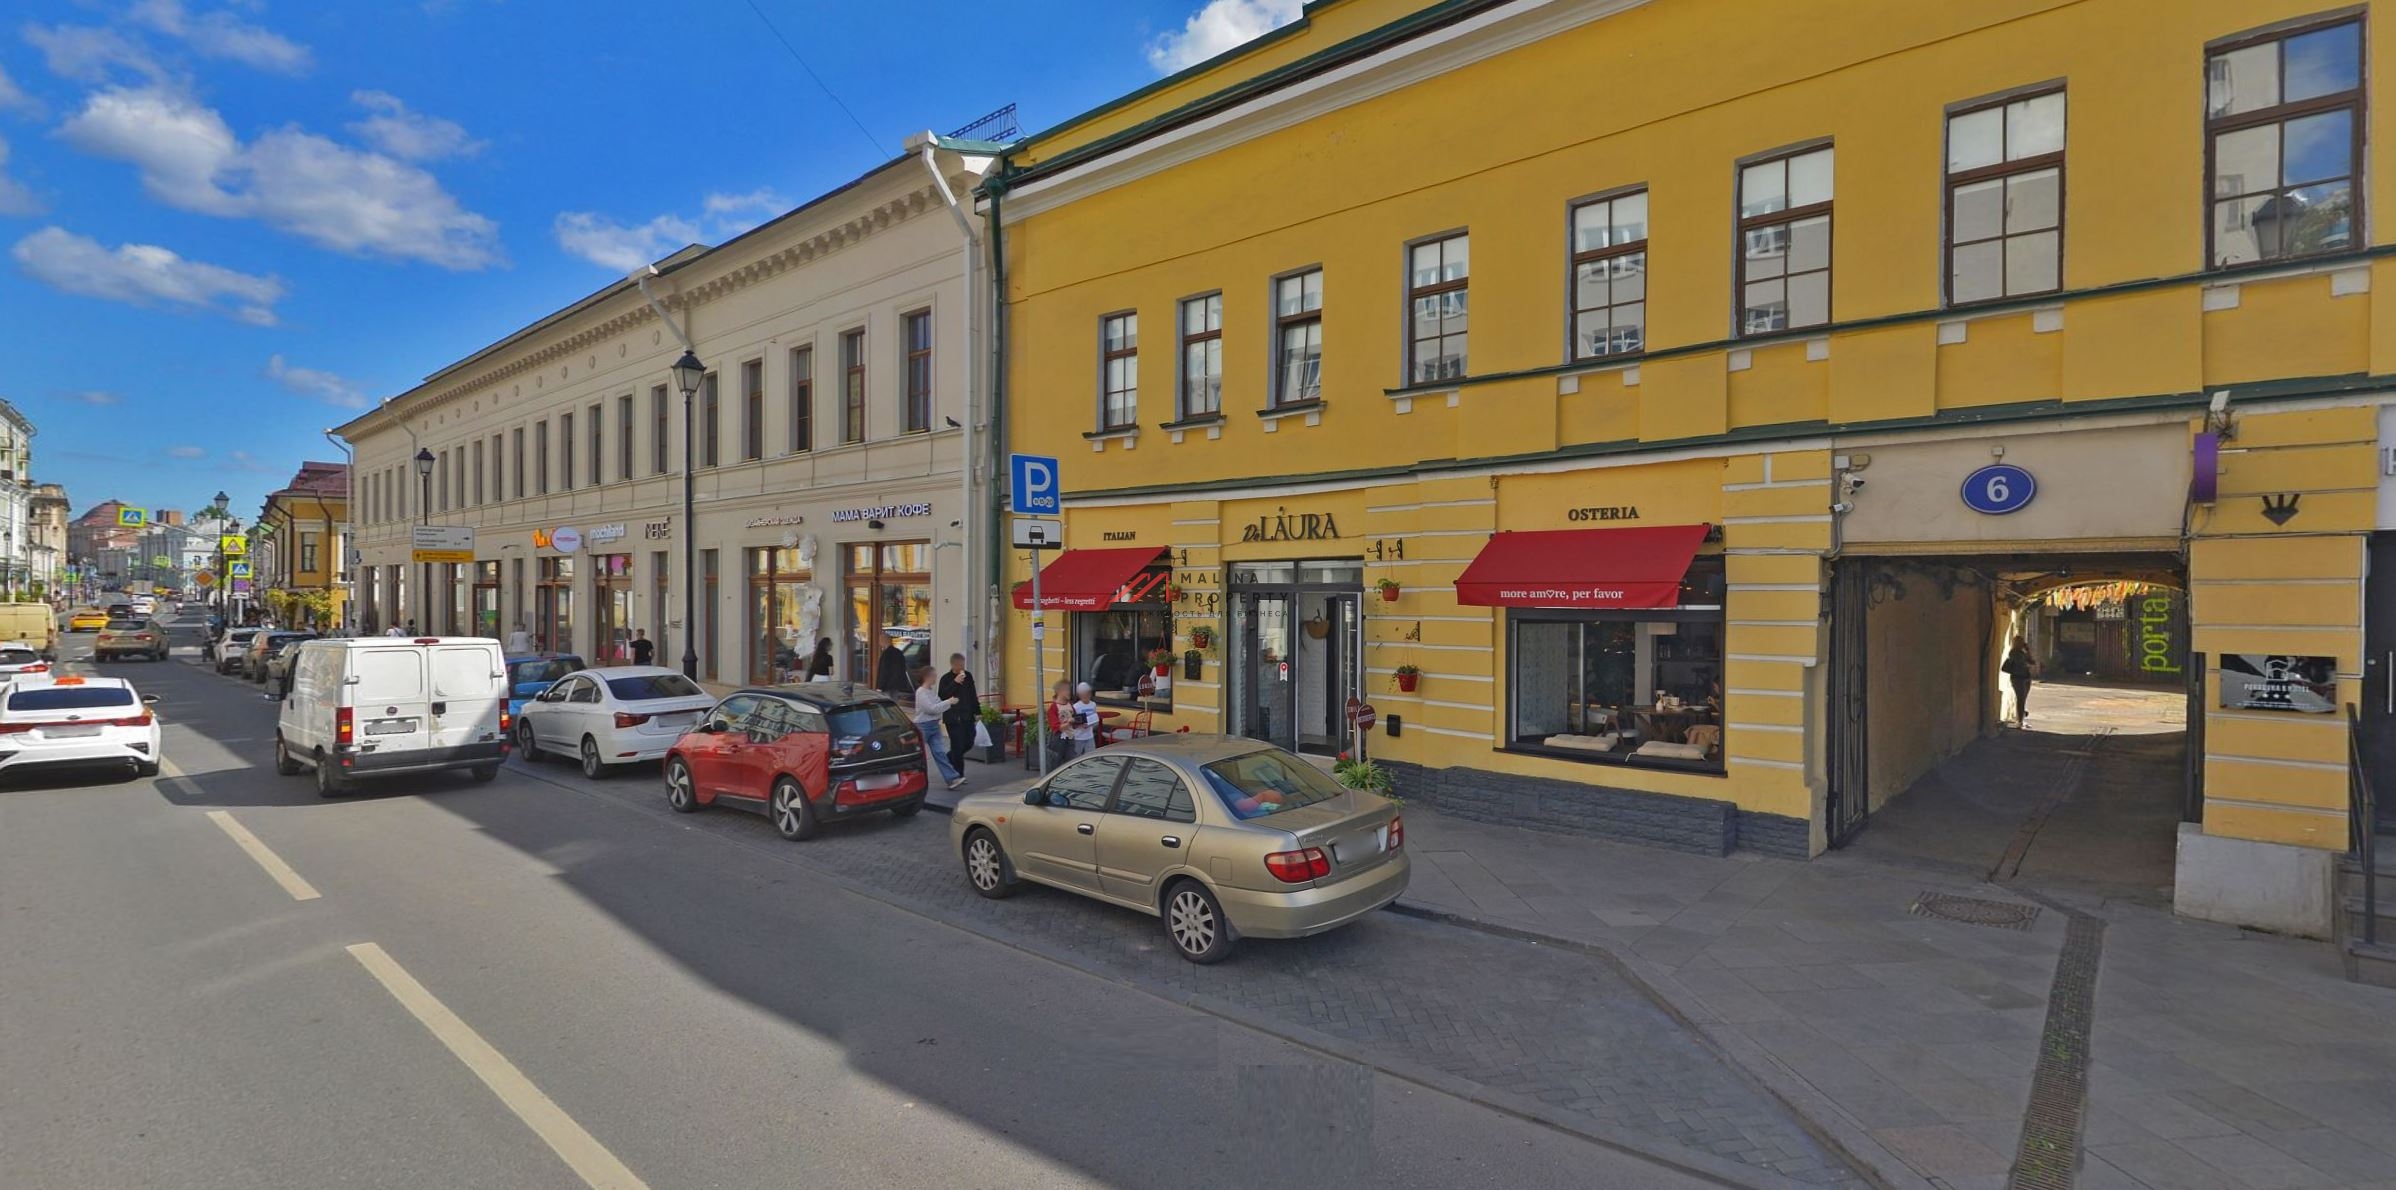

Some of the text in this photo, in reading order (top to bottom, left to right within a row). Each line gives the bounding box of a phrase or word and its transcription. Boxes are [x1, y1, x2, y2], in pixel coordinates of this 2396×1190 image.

[1025, 461, 1051, 508] P
[1987, 476, 2009, 502] 6
[832, 503, 932, 522] МАМА ВАРИТ КОФЕ
[1568, 506, 1640, 520] OSTERIA
[1103, 531, 1136, 541] ITALIAN
[1572, 591, 1591, 600] per
[1594, 588, 1624, 599] favor
[2140, 598, 2182, 673] porta
